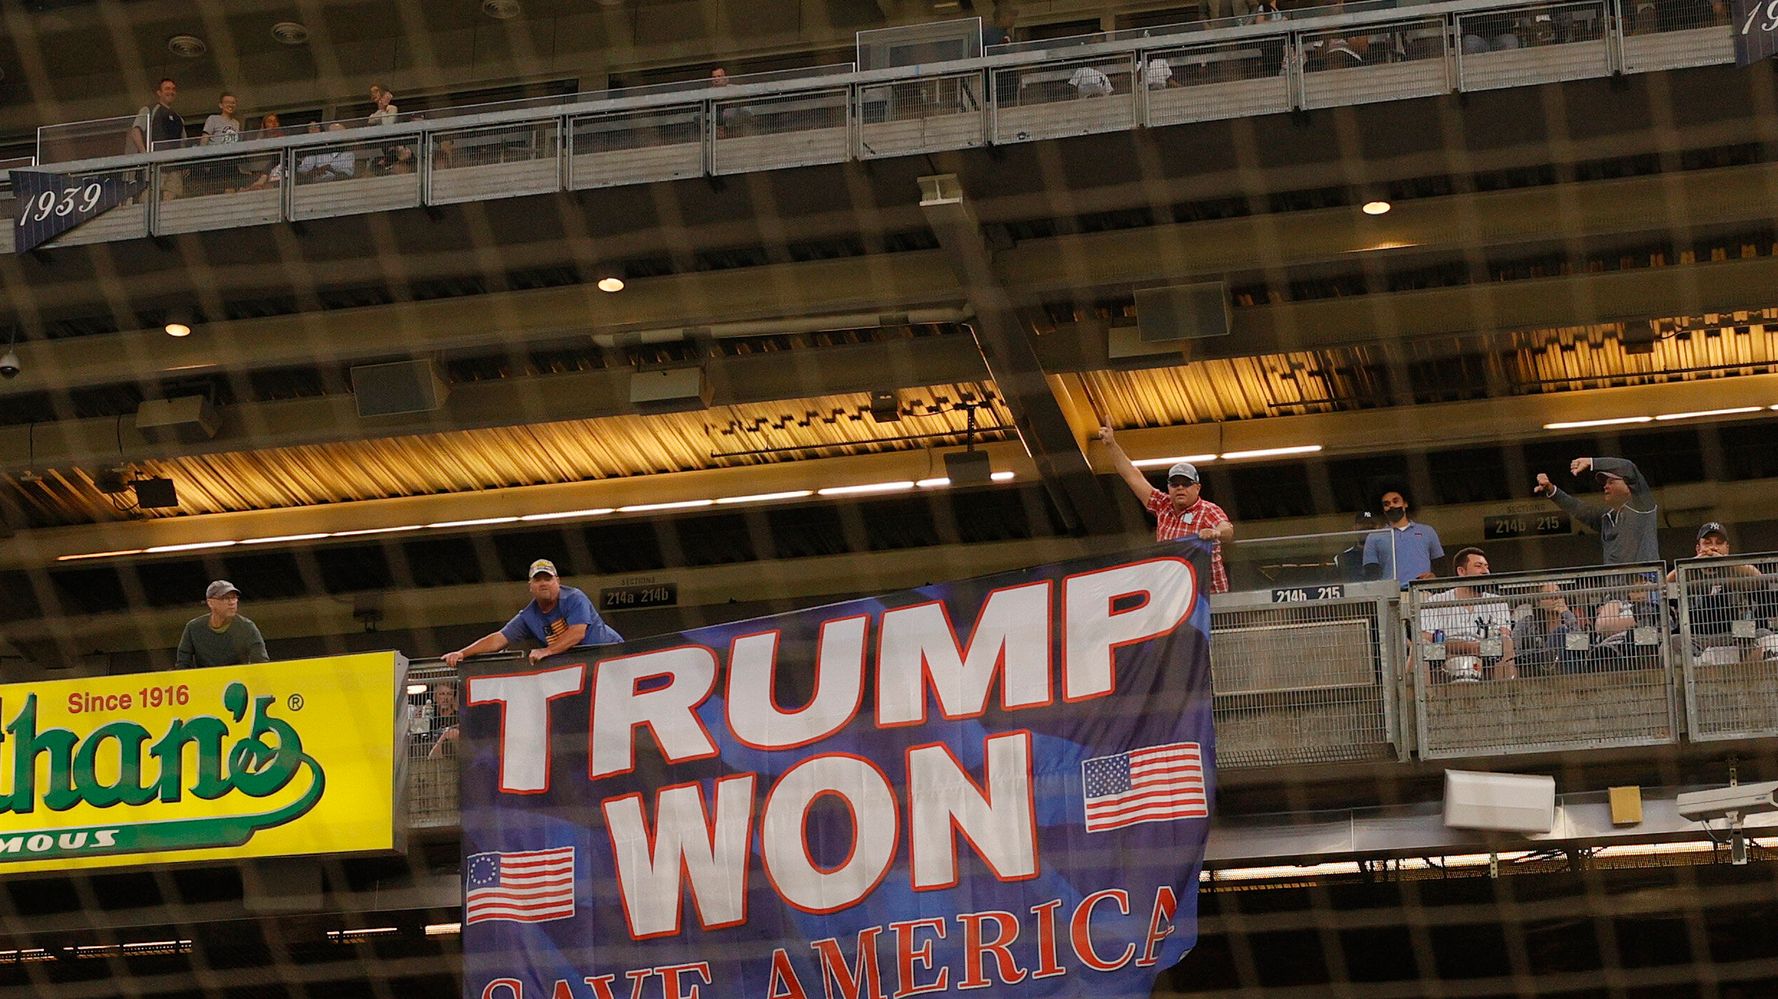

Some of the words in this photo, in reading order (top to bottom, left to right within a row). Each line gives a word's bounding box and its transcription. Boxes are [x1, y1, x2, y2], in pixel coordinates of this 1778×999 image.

[20, 183, 101, 227] 1939
[1495, 518, 1527, 534] 214b
[1537, 516, 1560, 530] 215
[607, 590, 635, 605] 214a
[640, 587, 669, 603] 214b
[1318, 586, 1341, 600] 215
[466, 556, 1197, 793] TRUMP
[67, 692, 132, 714] Since
[139, 684, 190, 708] 1916
[601, 729, 1041, 941] WON
[767, 886, 1178, 999] AMERICA
